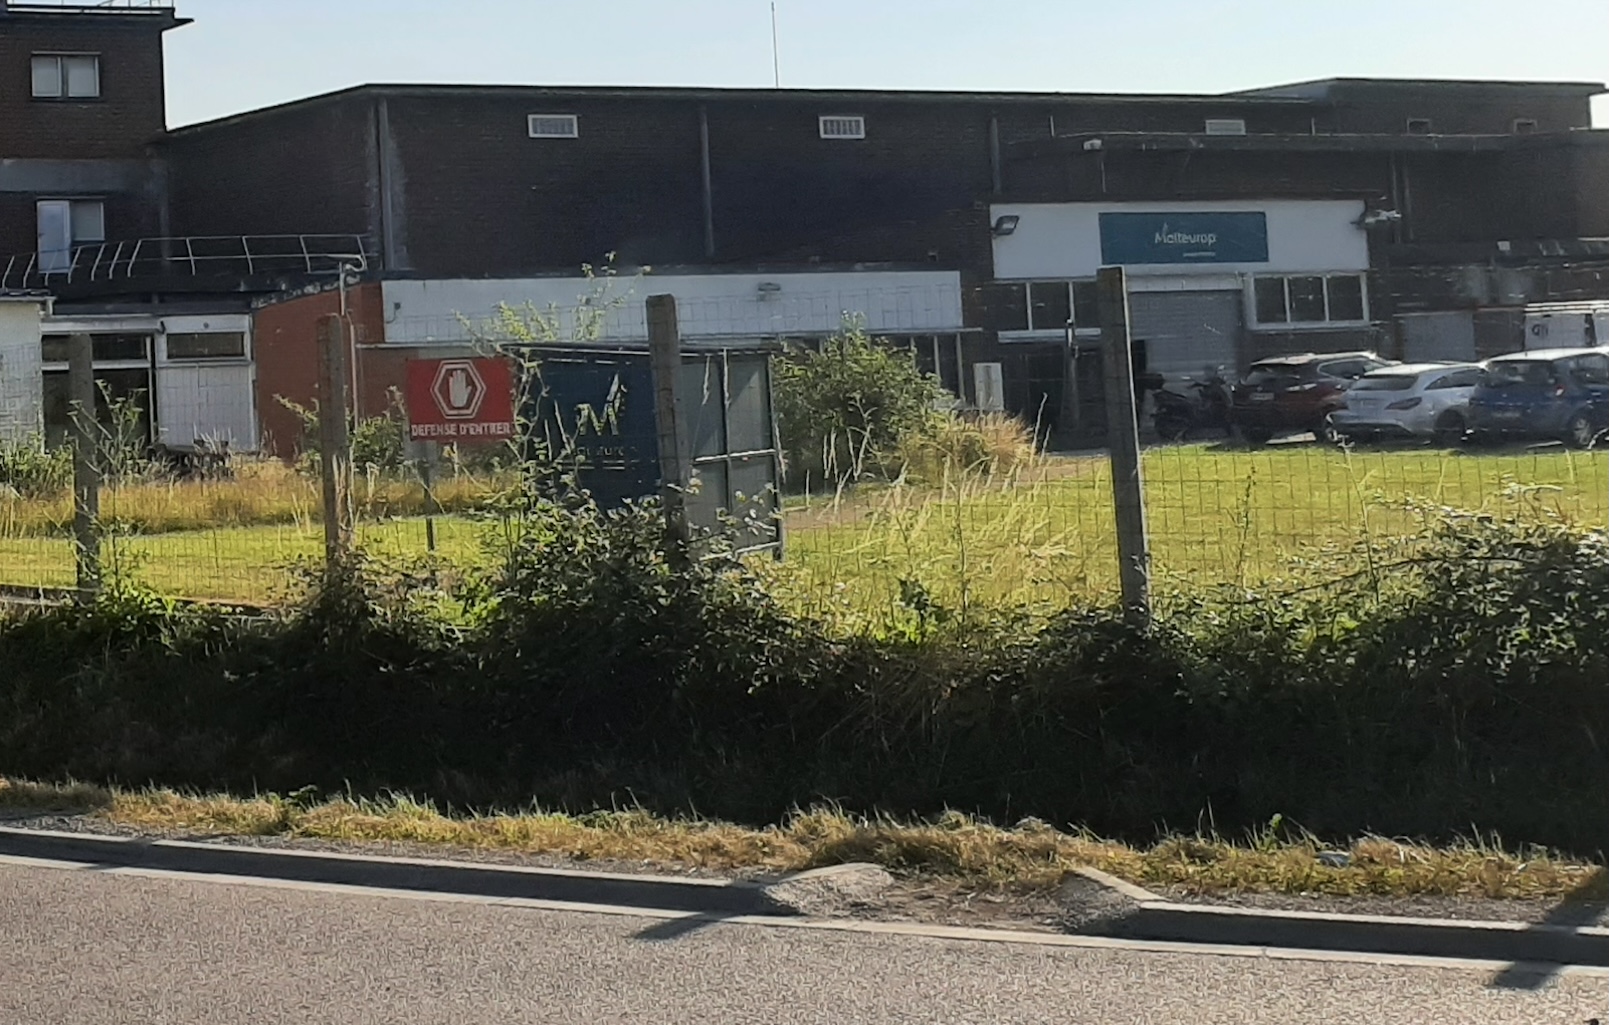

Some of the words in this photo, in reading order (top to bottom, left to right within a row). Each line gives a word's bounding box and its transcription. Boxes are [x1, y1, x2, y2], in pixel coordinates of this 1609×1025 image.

[1155, 223, 1217, 246] Malteurop
[411, 423, 457, 436] DEFENSE
[459, 422, 511, 435] D'ENTRER
